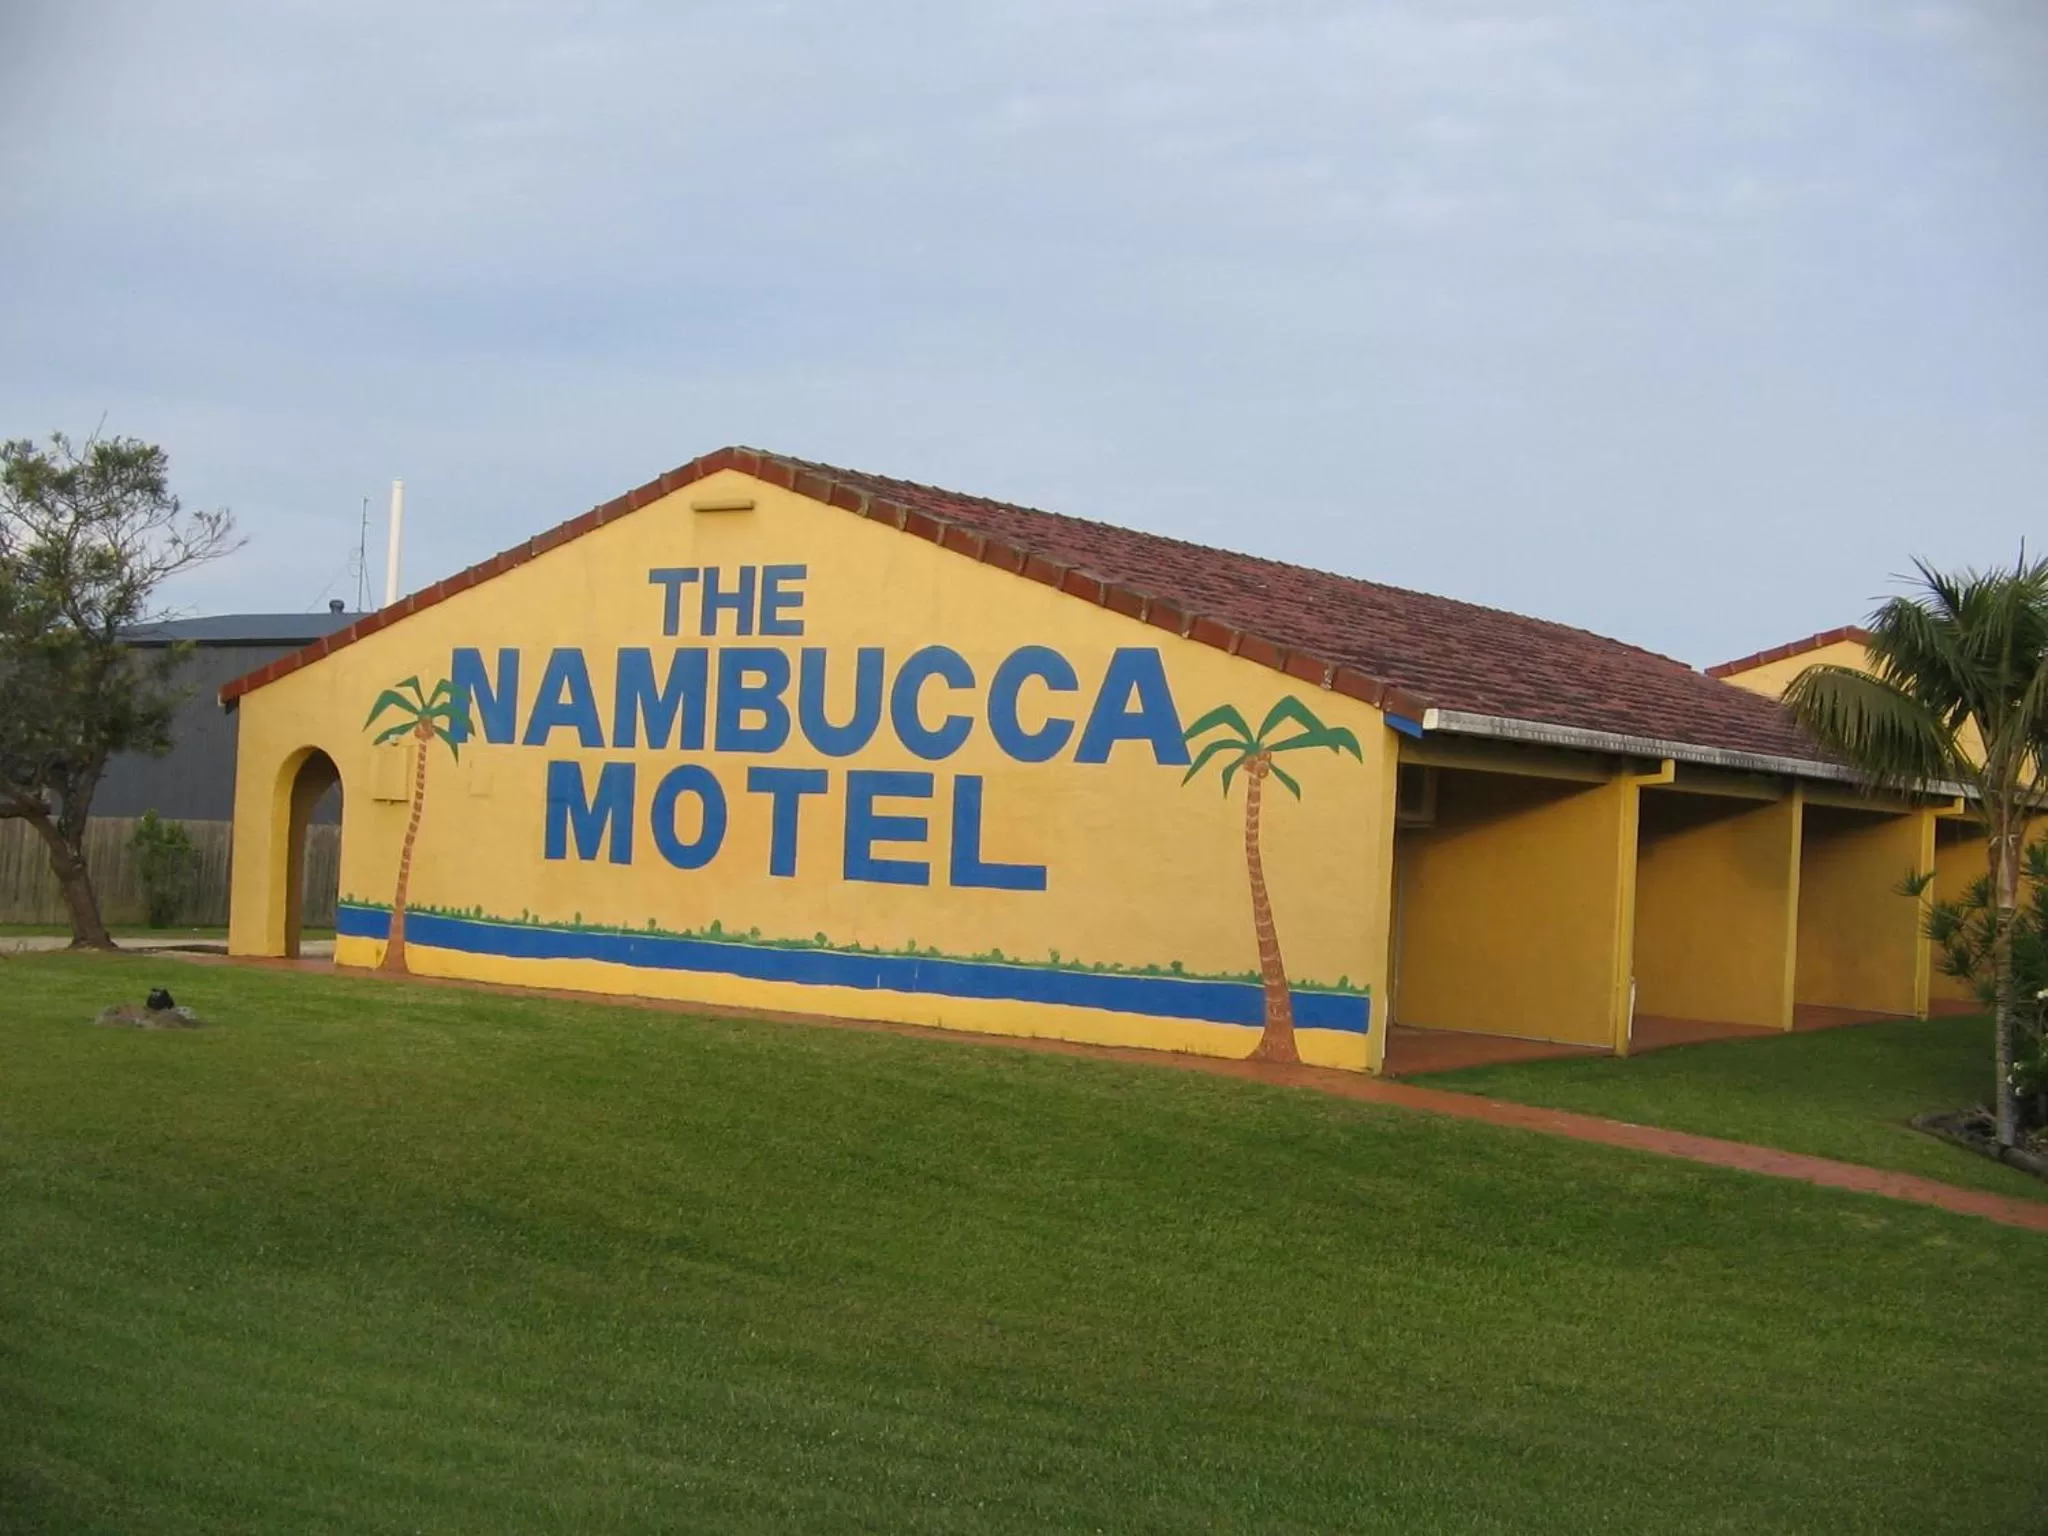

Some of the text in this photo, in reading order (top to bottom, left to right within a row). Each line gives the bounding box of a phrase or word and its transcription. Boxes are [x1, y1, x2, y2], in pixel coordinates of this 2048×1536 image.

[649, 564, 807, 637] THE
[452, 645, 1191, 766] NAMBUCCA
[545, 760, 1047, 891] MOTEL
